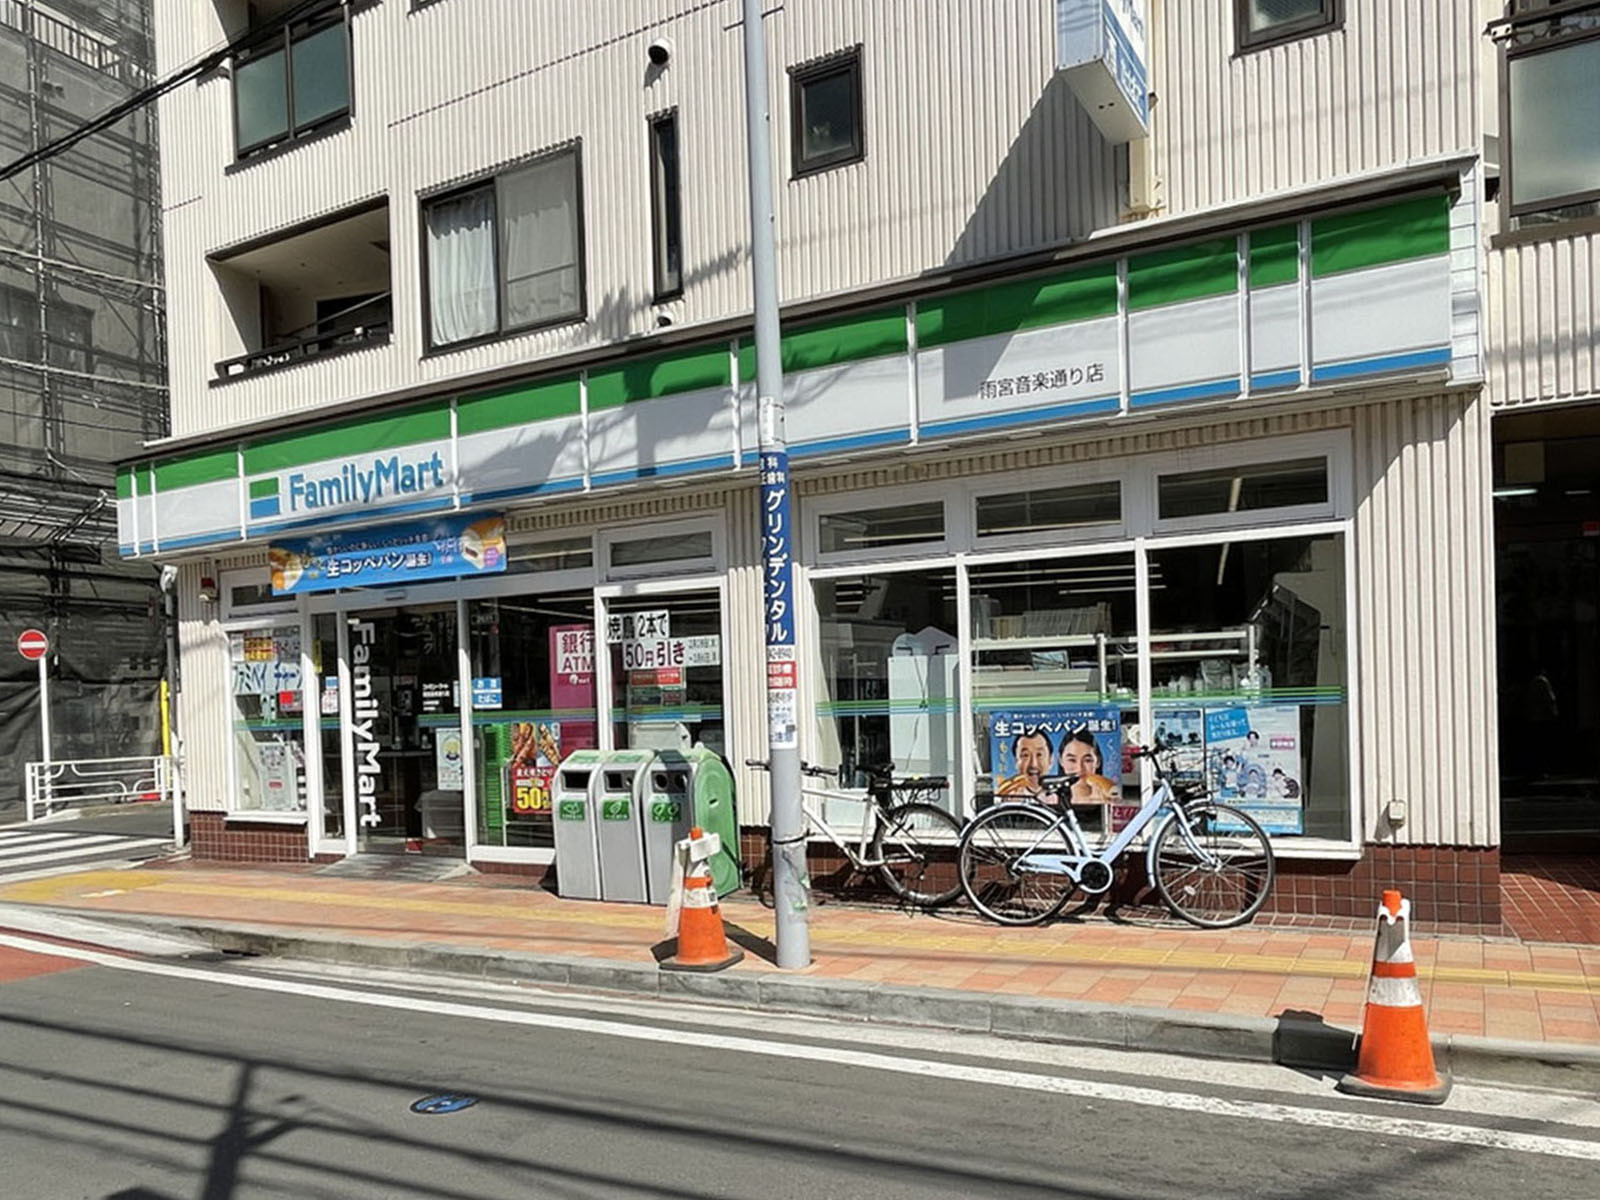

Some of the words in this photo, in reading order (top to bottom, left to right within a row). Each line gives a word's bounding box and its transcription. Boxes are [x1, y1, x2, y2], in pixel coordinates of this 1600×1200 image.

[980, 363, 1104, 399] 雨宮音楽通り店
[289, 451, 444, 511] FamilyMart
[767, 489, 788, 642] グリンデンタル
[625, 641, 686, 668] 50円引き
[351, 622, 382, 827] FamilyMart
